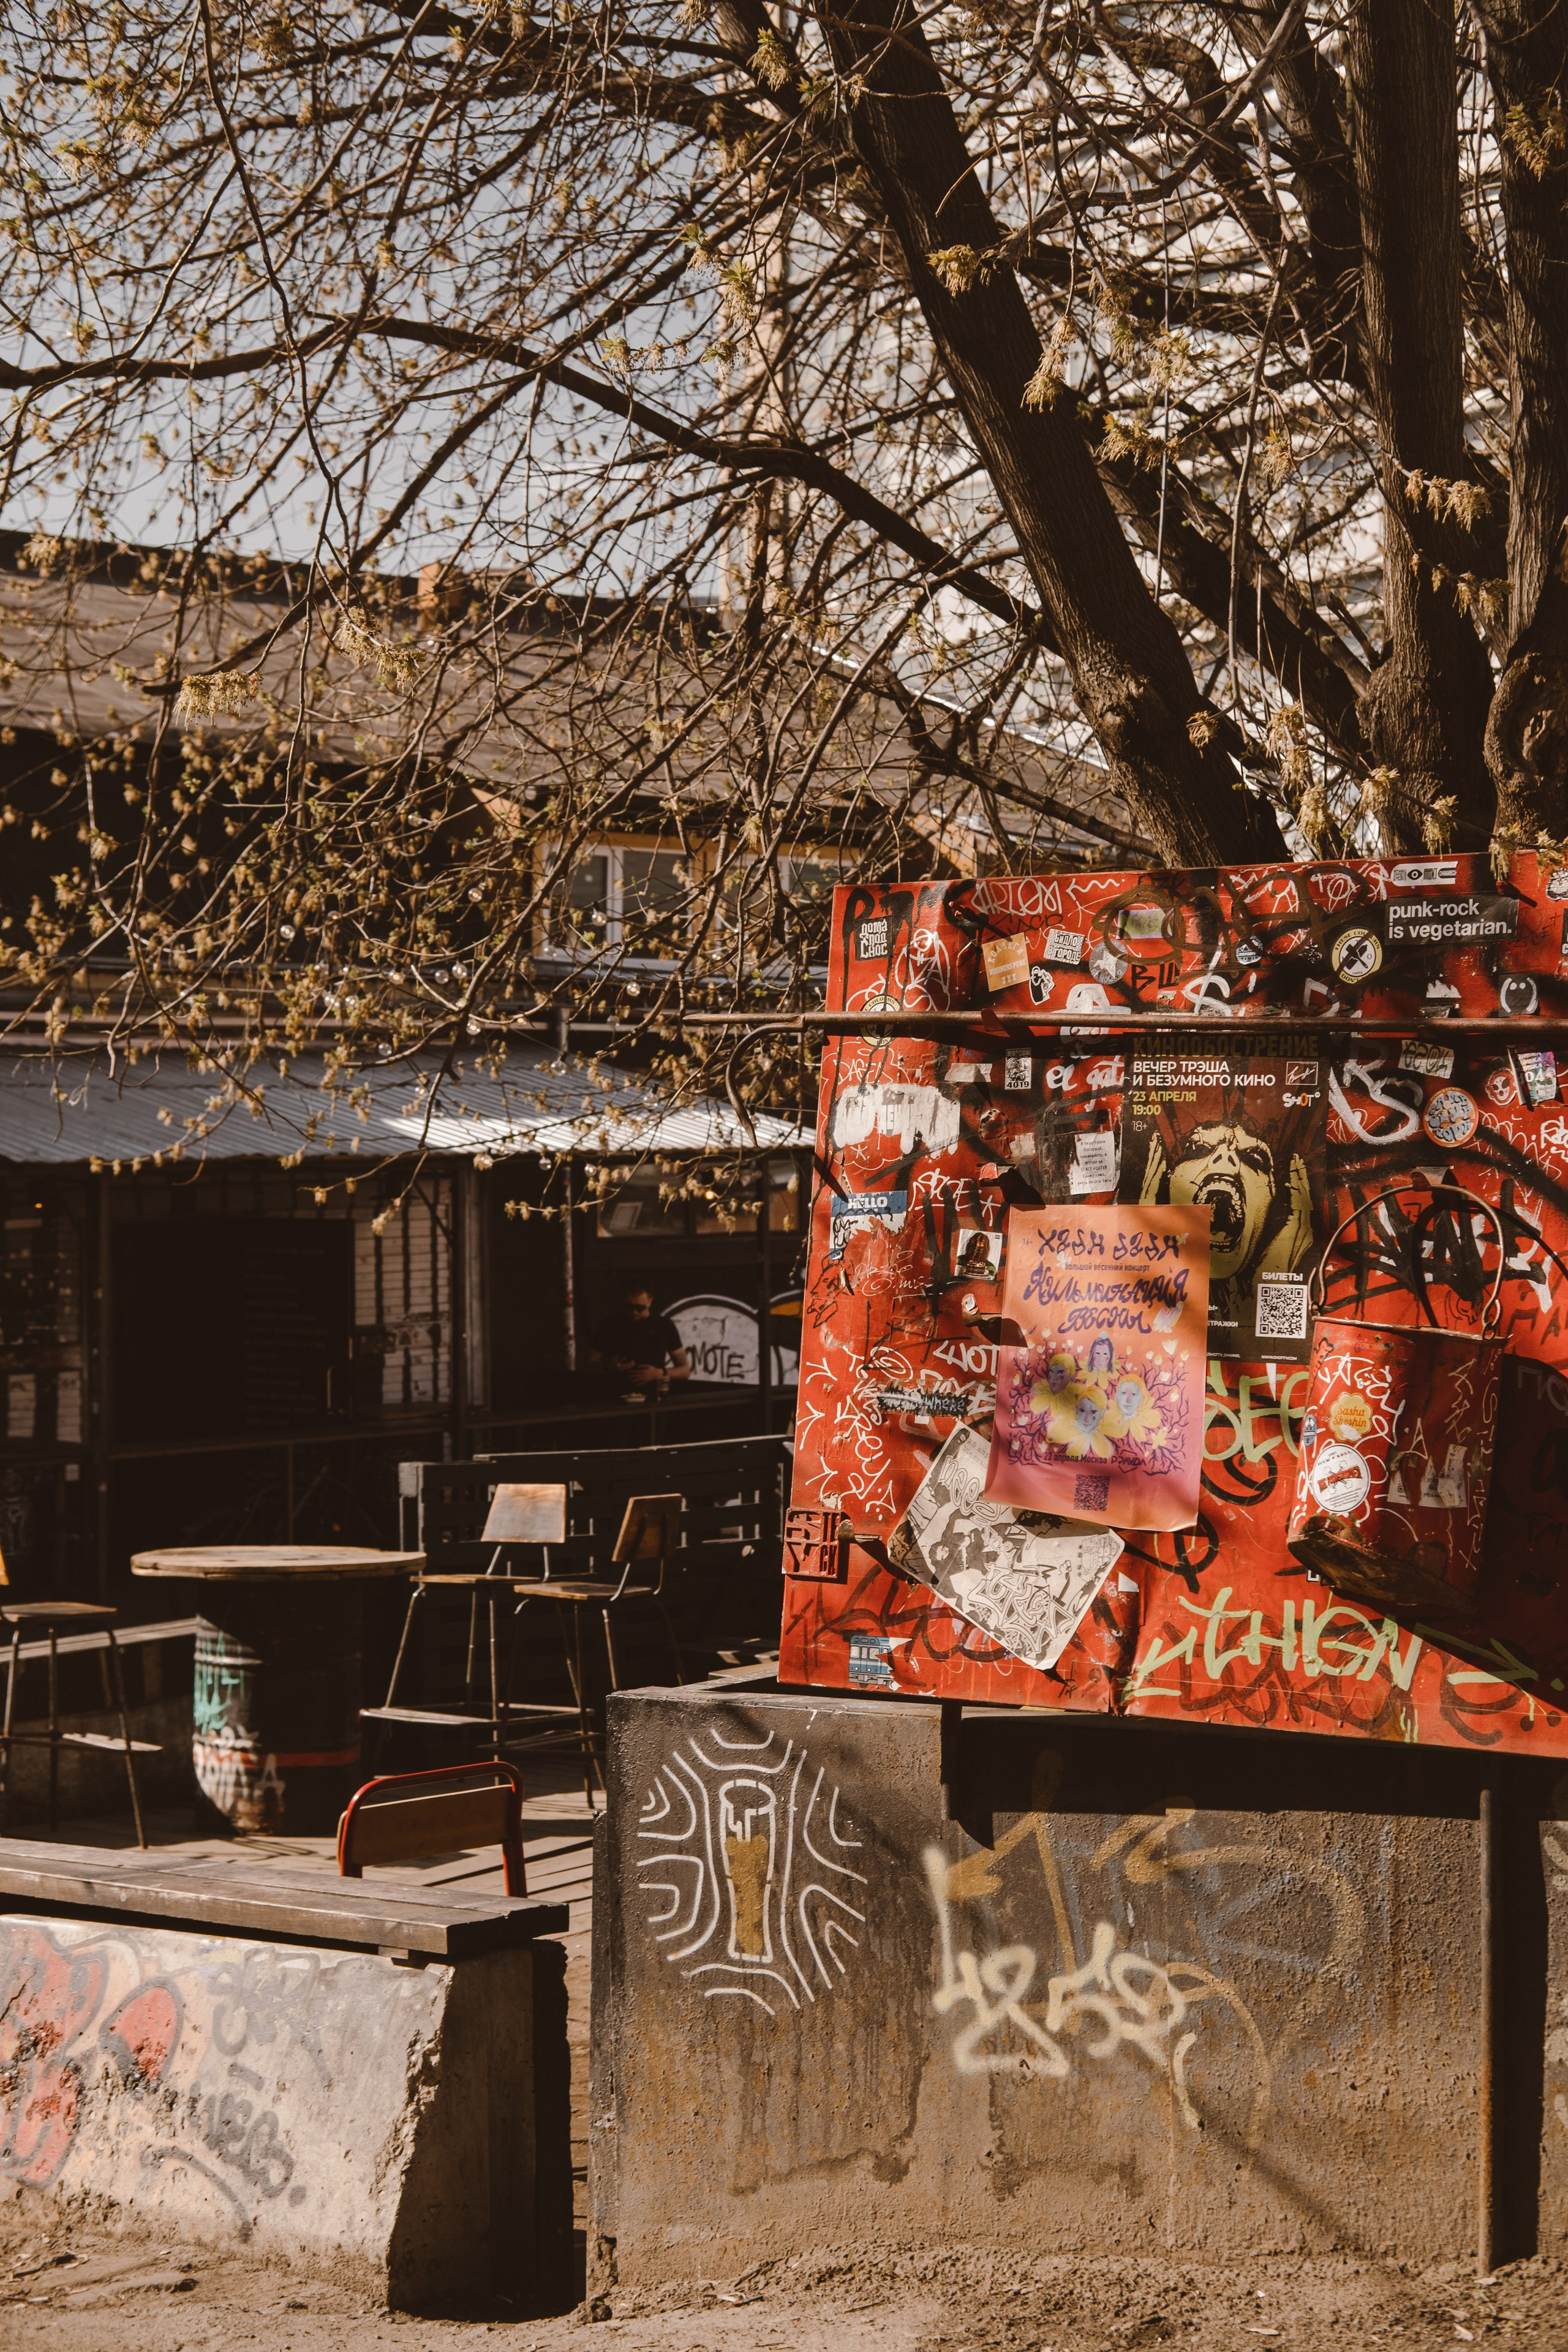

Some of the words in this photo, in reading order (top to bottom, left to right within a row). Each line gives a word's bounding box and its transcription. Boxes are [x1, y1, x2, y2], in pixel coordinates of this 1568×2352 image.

[1389, 899, 1480, 922] punk-rock
[1389, 922, 1404, 939] is
[1409, 919, 1512, 941] vegetarian.
[1133, 1061, 1177, 1072] ВЕЧЕР
[1179, 1061, 1229, 1072] ТРЭША
[1133, 1075, 1142, 1086] И
[1147, 1074, 1231, 1086] БЕЗУМНОГО
[1234, 1074, 1276, 1087] КИНО
[1133, 1091, 1146, 1102] 23
[1148, 1091, 1197, 1102] АПРЕЛЯ
[1132, 1105, 1161, 1115] 19:00
[1132, 1121, 1148, 1132] 18+
[848, 1196, 888, 1209] HELLO
[1065, 1262, 1092, 1271] большой
[1094, 1263, 1123, 1272] весенний
[1125, 1264, 1150, 1273] концерт
[1262, 1272, 1303, 1281] БИЛЕТЫ
[1337, 1404, 1365, 1417] Sasha
[1044, 1452, 1052, 1461] 23
[1054, 1454, 1079, 1464] апреля
[1080, 1454, 1107, 1464] Москва
